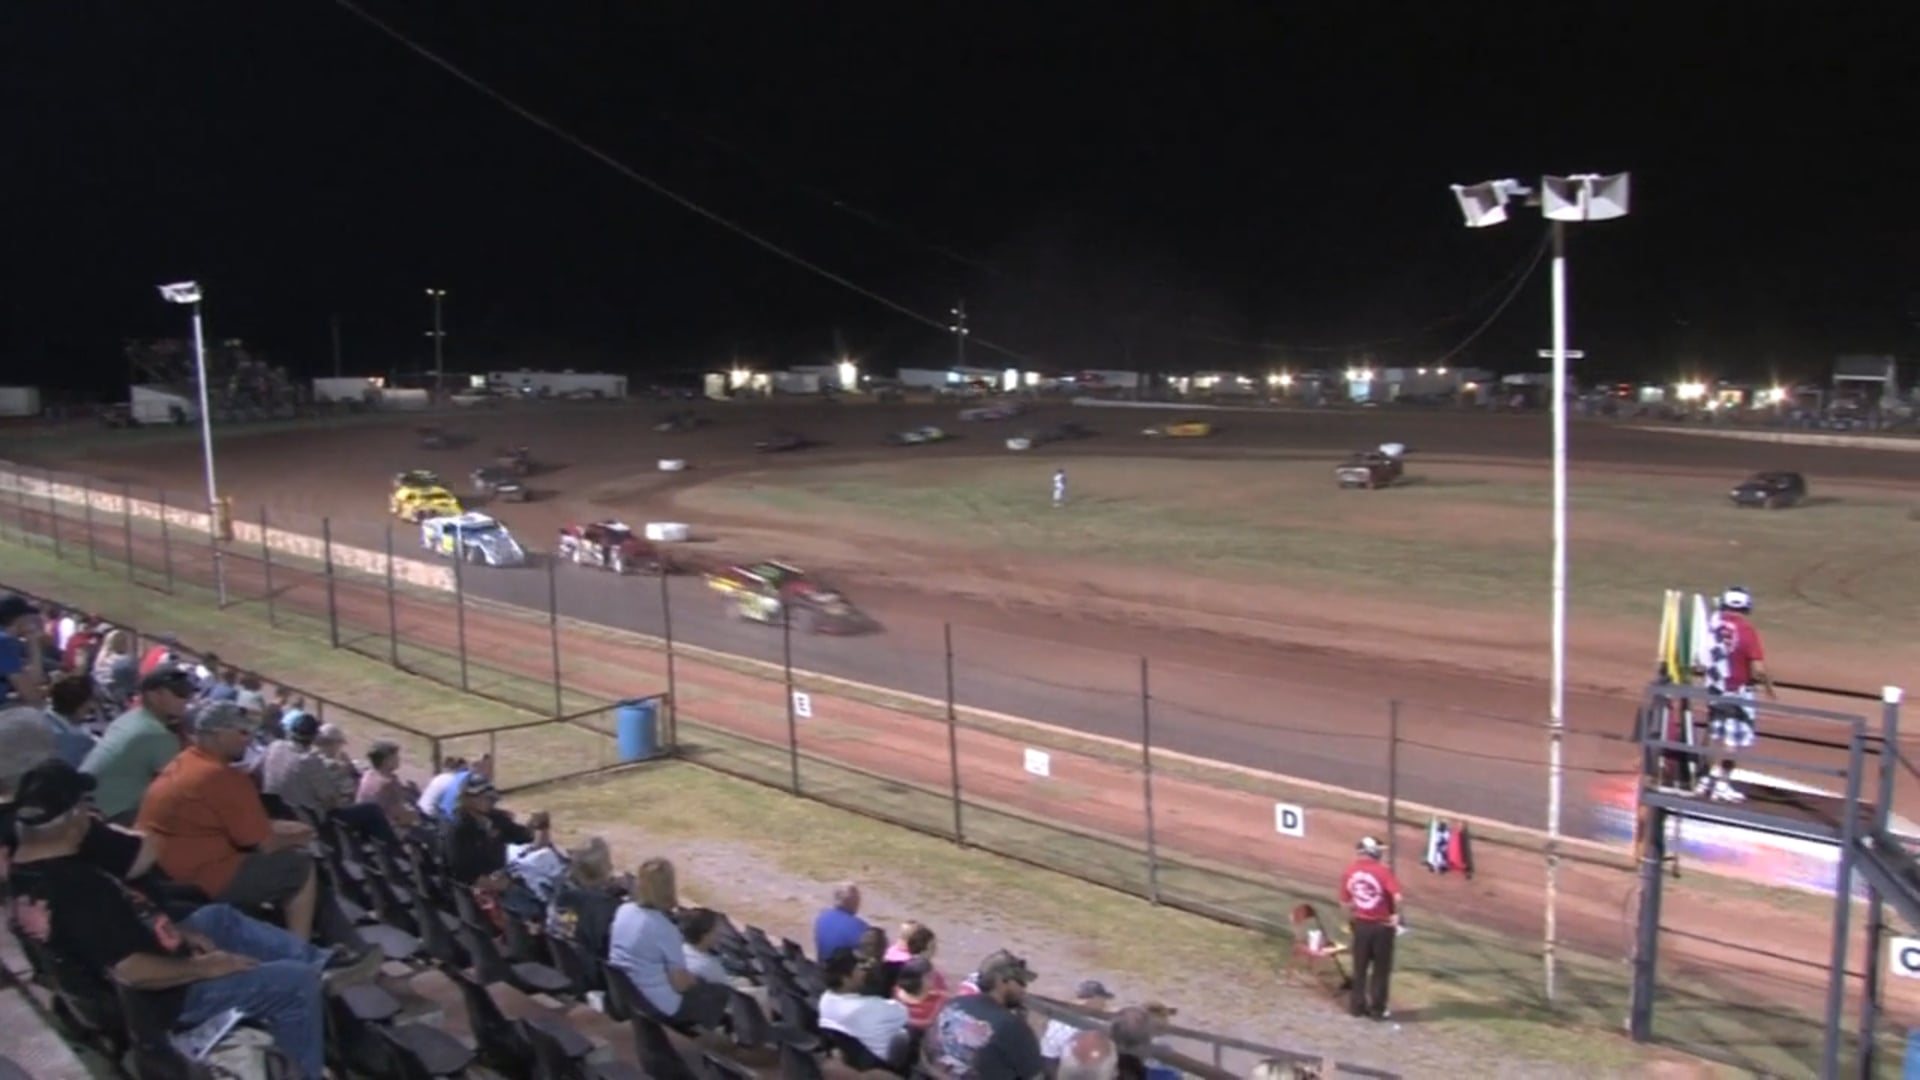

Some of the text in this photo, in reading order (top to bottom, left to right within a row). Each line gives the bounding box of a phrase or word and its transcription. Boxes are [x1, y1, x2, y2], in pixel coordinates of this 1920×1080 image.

[797, 696, 807, 711] E
[1282, 809, 1298, 829] D
[1900, 946, 1920, 971] C
